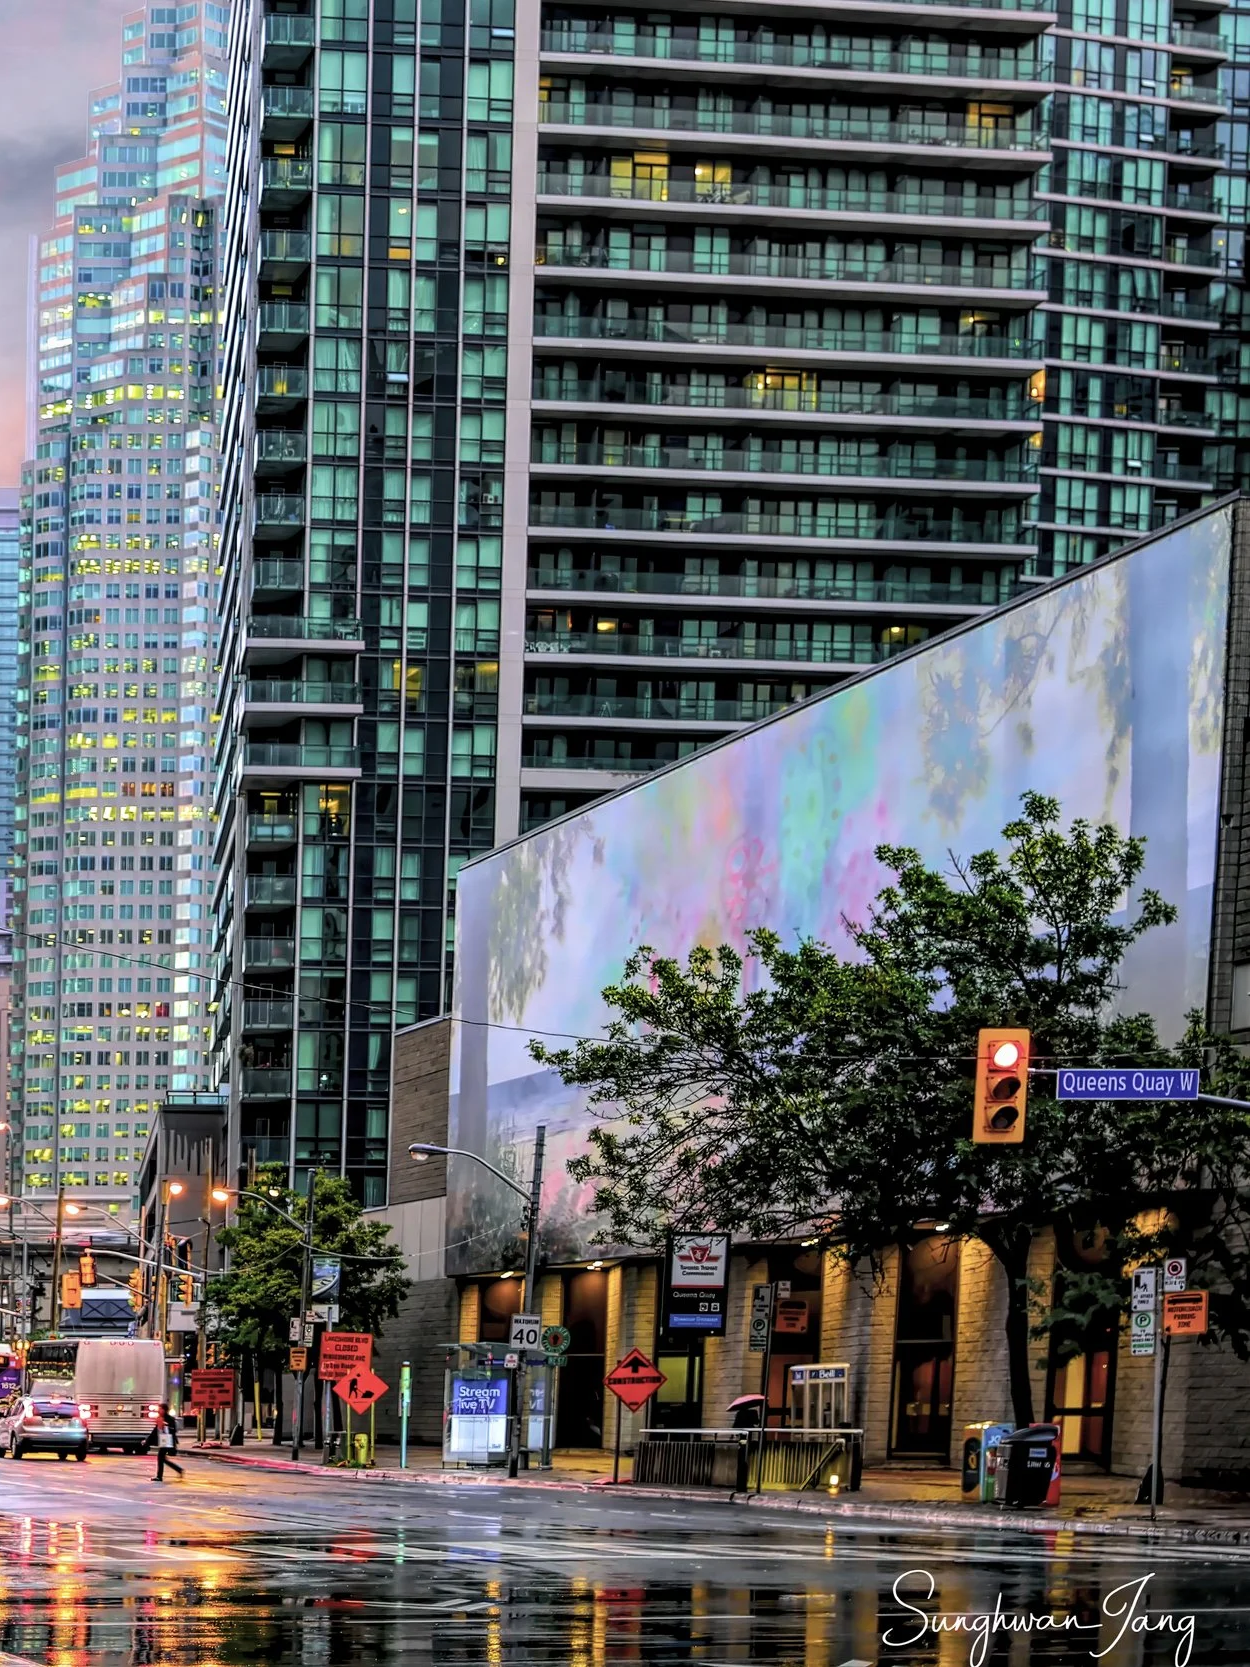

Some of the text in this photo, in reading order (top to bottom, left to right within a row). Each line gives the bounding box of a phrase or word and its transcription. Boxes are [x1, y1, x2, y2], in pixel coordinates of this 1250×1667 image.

[1063, 1072, 1195, 1096] Queens Quay W
[673, 1291, 716, 1299] Queens Quay
[512, 1328, 538, 1345] 40
[334, 1344, 359, 1352] CLOSED
[819, 1369, 836, 1379] Bell
[607, 1376, 662, 1385] CONSTRUCTION
[459, 1386, 501, 1397] Stream
[478, 1398, 496, 1410] TV
